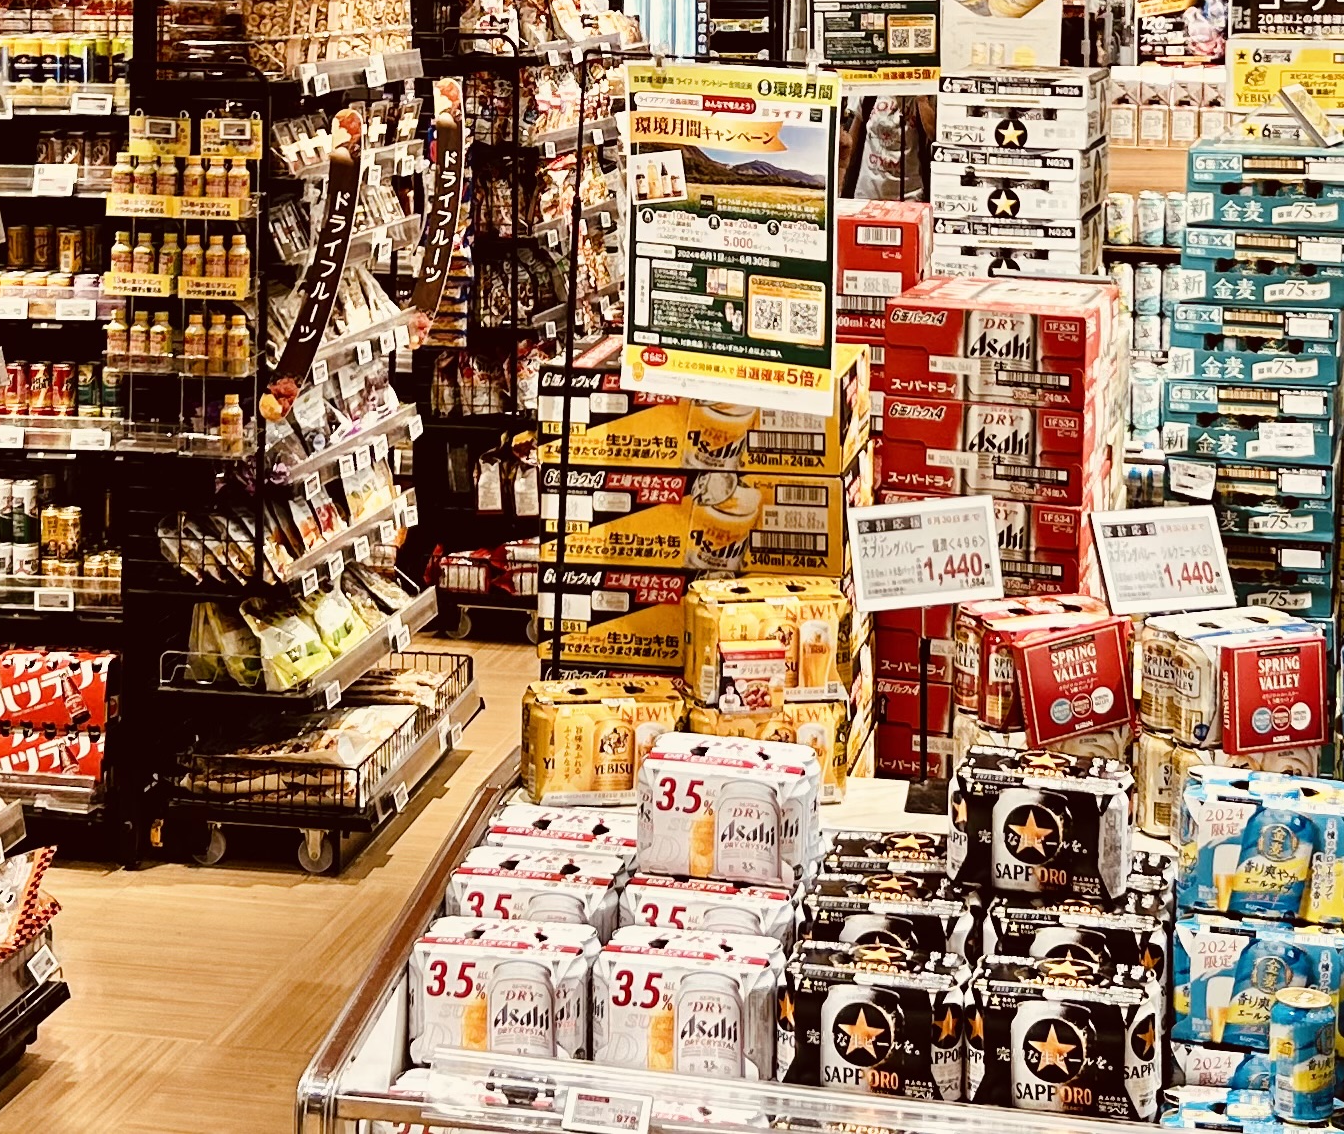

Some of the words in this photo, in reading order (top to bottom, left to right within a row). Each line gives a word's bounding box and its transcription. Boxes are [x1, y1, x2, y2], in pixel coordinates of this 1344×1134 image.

[773, 80, 834, 101] 環境月間
[1055, 86, 1081, 96] N026
[634, 116, 776, 145] 環境月間キャンペーン
[941, 130, 986, 143] 黒ラベル
[1046, 158, 1071, 168] N026
[934, 200, 978, 213] 黒ラベル
[1219, 199, 1264, 222] 金麦
[424, 150, 458, 284] ドライフルーツ
[1047, 227, 1073, 237] N026
[881, 250, 902, 259] ビール
[297, 191, 352, 344] ドライフルーツ
[1211, 277, 1257, 300] 金麦
[983, 318, 1019, 332] DRY
[1047, 322, 1077, 333] 1F534
[1057, 333, 1079, 342] ビール
[969, 331, 1031, 361] Asahi
[1201, 356, 1245, 379] 金麦
[891, 378, 957, 394] スーパードライ
[983, 414, 1018, 427] DRY
[1047, 418, 1076, 428] 1F534
[606, 434, 678, 449] 生ジョッキ缶
[968, 426, 1031, 455] Asahi
[1056, 429, 1078, 438] ビール
[1195, 432, 1238, 455] 金麦
[607, 474, 683, 489] 工場できたての
[887, 472, 955, 488] スーパードライ
[639, 489, 681, 502] うまさへ
[926, 512, 981, 526] 6月30日まで
[1043, 513, 1072, 524] 1F534
[1051, 524, 1074, 534] ビール
[609, 532, 681, 548] 生ジョッキ缶
[860, 535, 887, 545] キリン
[860, 541, 925, 559] スプリングバレー
[923, 552, 984, 586] 1,440
[1163, 560, 1215, 592] 1,440
[606, 573, 682, 588] 工場できたての
[638, 589, 679, 603] うまさへ
[785, 604, 833, 620] NEW!
[607, 632, 680, 648] 生ジョッキ缶
[1050, 642, 1097, 667] SPRING
[1053, 659, 1098, 683] VALLEY
[1257, 655, 1300, 674] SPRING
[1258, 672, 1300, 692] VALLEY
[621, 706, 668, 722] NEW!
[782, 705, 830, 722] NEW!
[1074, 718, 1094, 731] KIRIN
[1272, 734, 1292, 743] KIRIN
[594, 763, 633, 775] YEBISU
[1205, 806, 1245, 822] 2024
[1210, 822, 1240, 837] 限定
[995, 862, 1067, 886] SAPPORO
[1243, 859, 1299, 882] 香り爽やか
[1244, 876, 1294, 893] エールタイプ
[1197, 939, 1238, 955] 2024
[1203, 955, 1233, 969] 限定
[505, 988, 538, 1002] DRY
[692, 1001, 727, 1015] DRY
[494, 1004, 550, 1032] Asahi
[680, 1013, 738, 1043] Asahi
[1193, 1055, 1233, 1072] 2024
[824, 1064, 900, 1091] SAPPORO
[1199, 1071, 1229, 1086] 限定
[1015, 1081, 1093, 1106] SAPPORO
